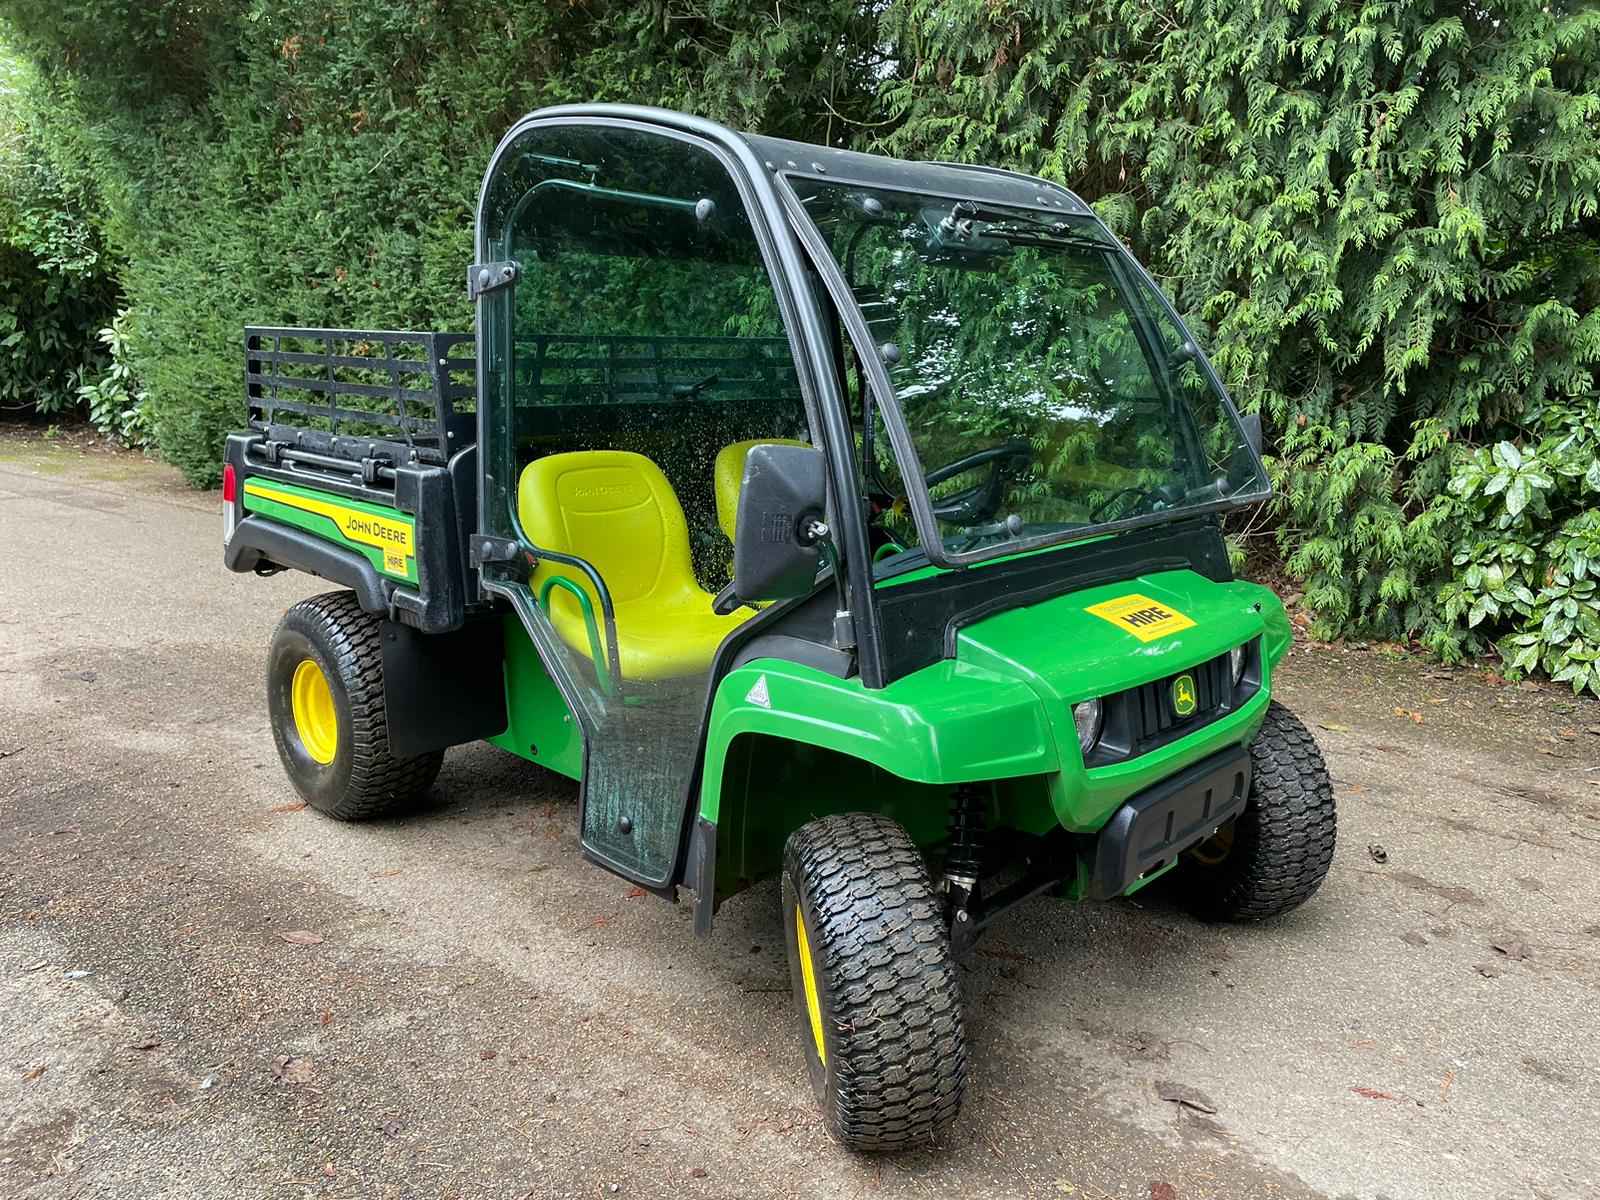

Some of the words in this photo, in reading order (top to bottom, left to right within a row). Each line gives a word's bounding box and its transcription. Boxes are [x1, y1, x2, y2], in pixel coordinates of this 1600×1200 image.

[346, 515, 371, 535] JOHN
[373, 522, 406, 545] DEERE
[1120, 606, 1173, 628] HIRE
